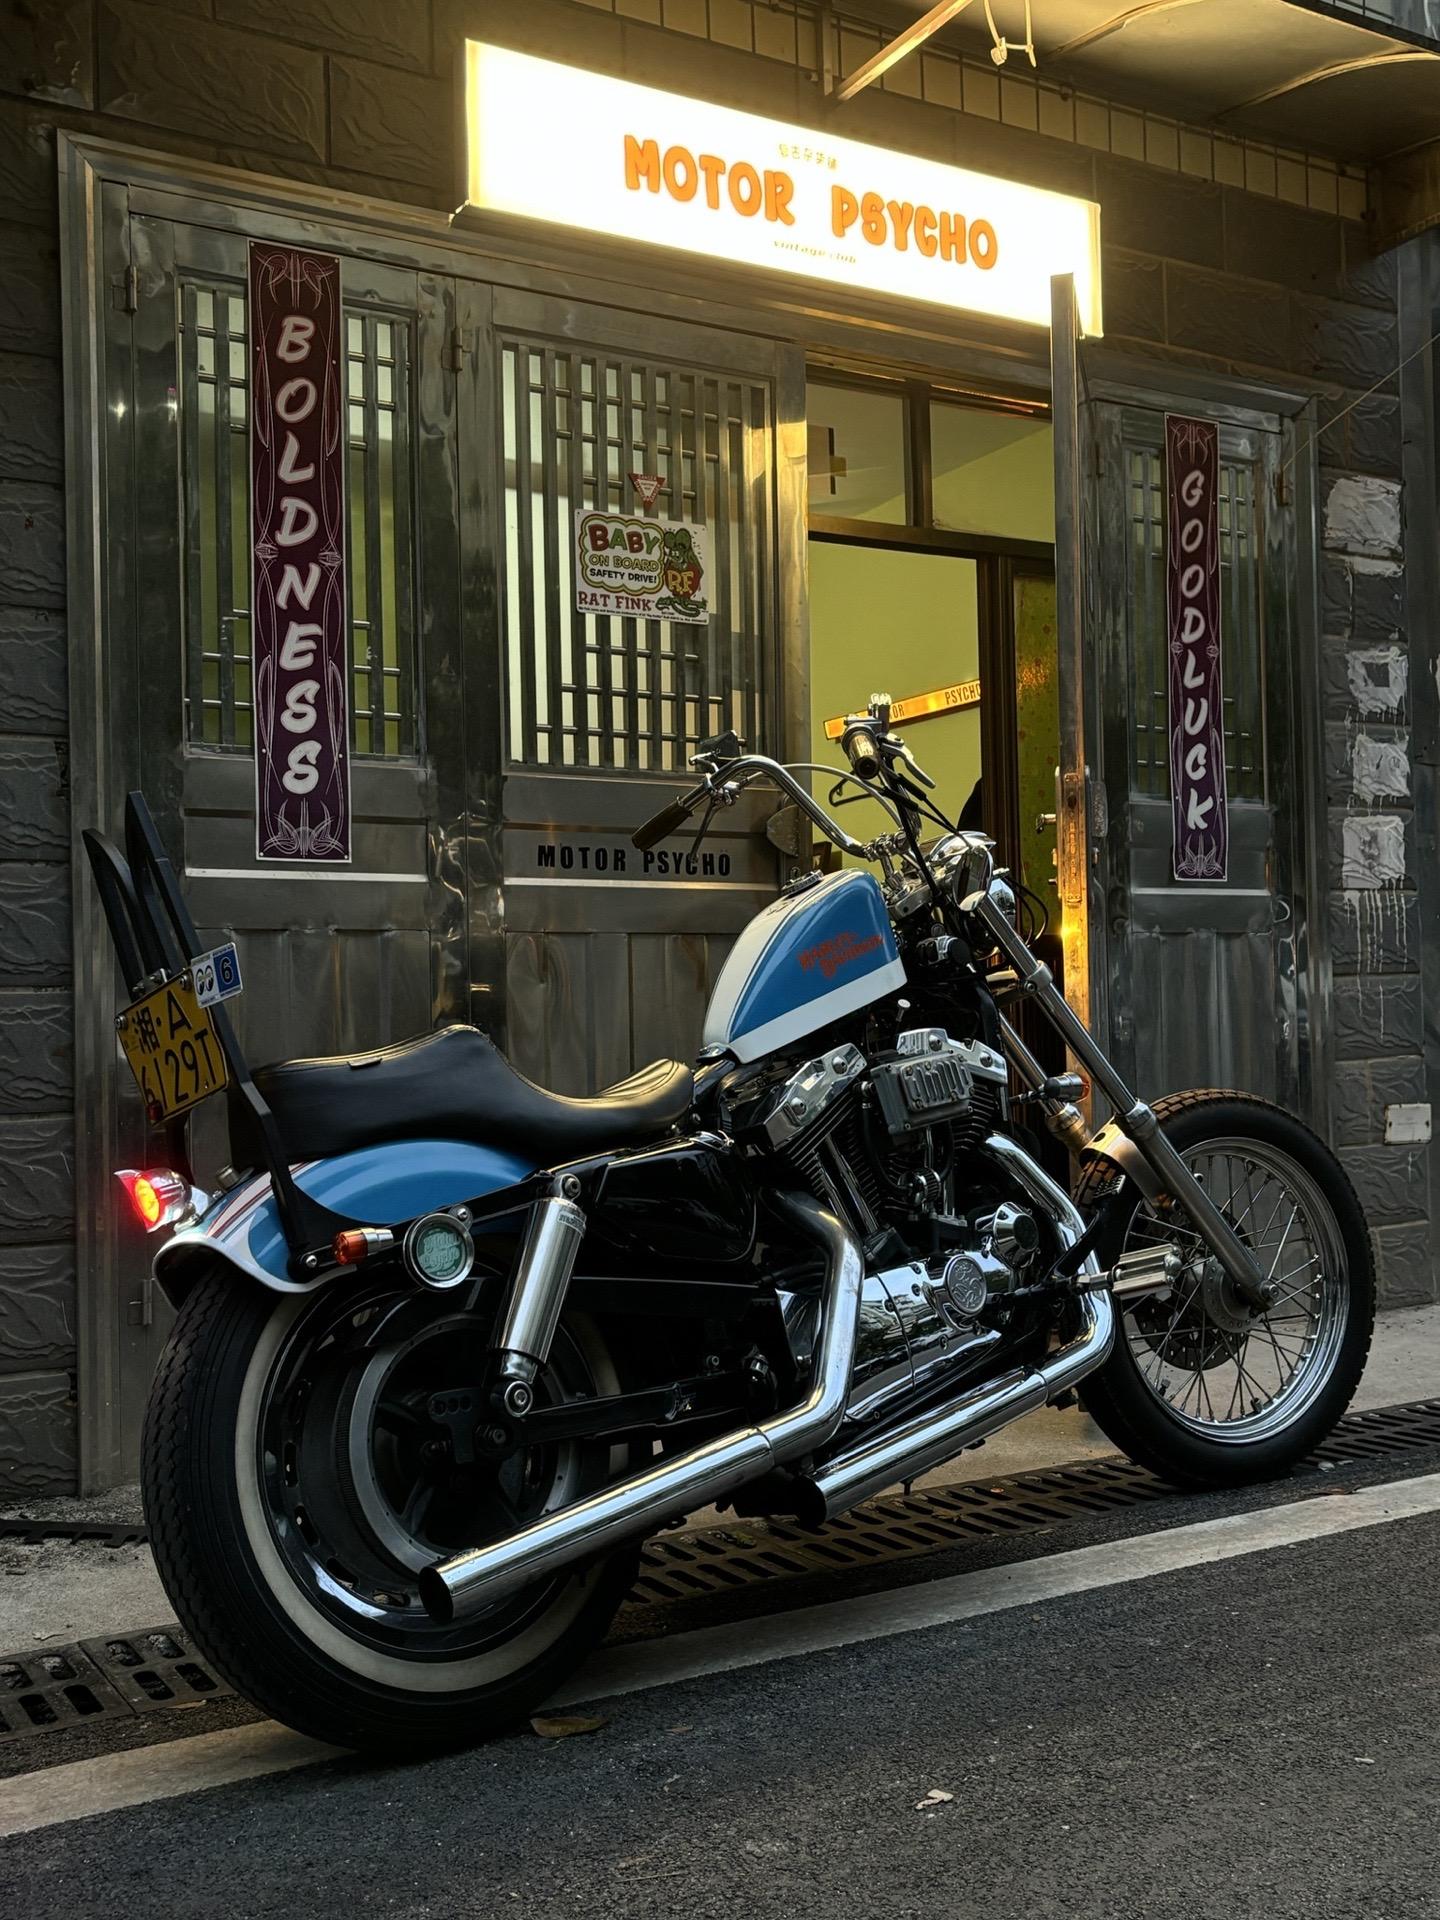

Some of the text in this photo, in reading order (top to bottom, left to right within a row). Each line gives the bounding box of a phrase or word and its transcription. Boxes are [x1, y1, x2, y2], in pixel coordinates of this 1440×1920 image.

[624, 134, 998, 270] MOTOR PSYCHO
[588, 524, 660, 555] BABY
[275, 315, 323, 795] BOLDNESS
[589, 554, 659, 573] ON BOARD
[589, 568, 657, 584] SAFETY DRIVE!
[578, 591, 652, 612] RAT FINK
[537, 844, 731, 877] MOTOR PSYCHO
[220, 956, 234, 985] 6
